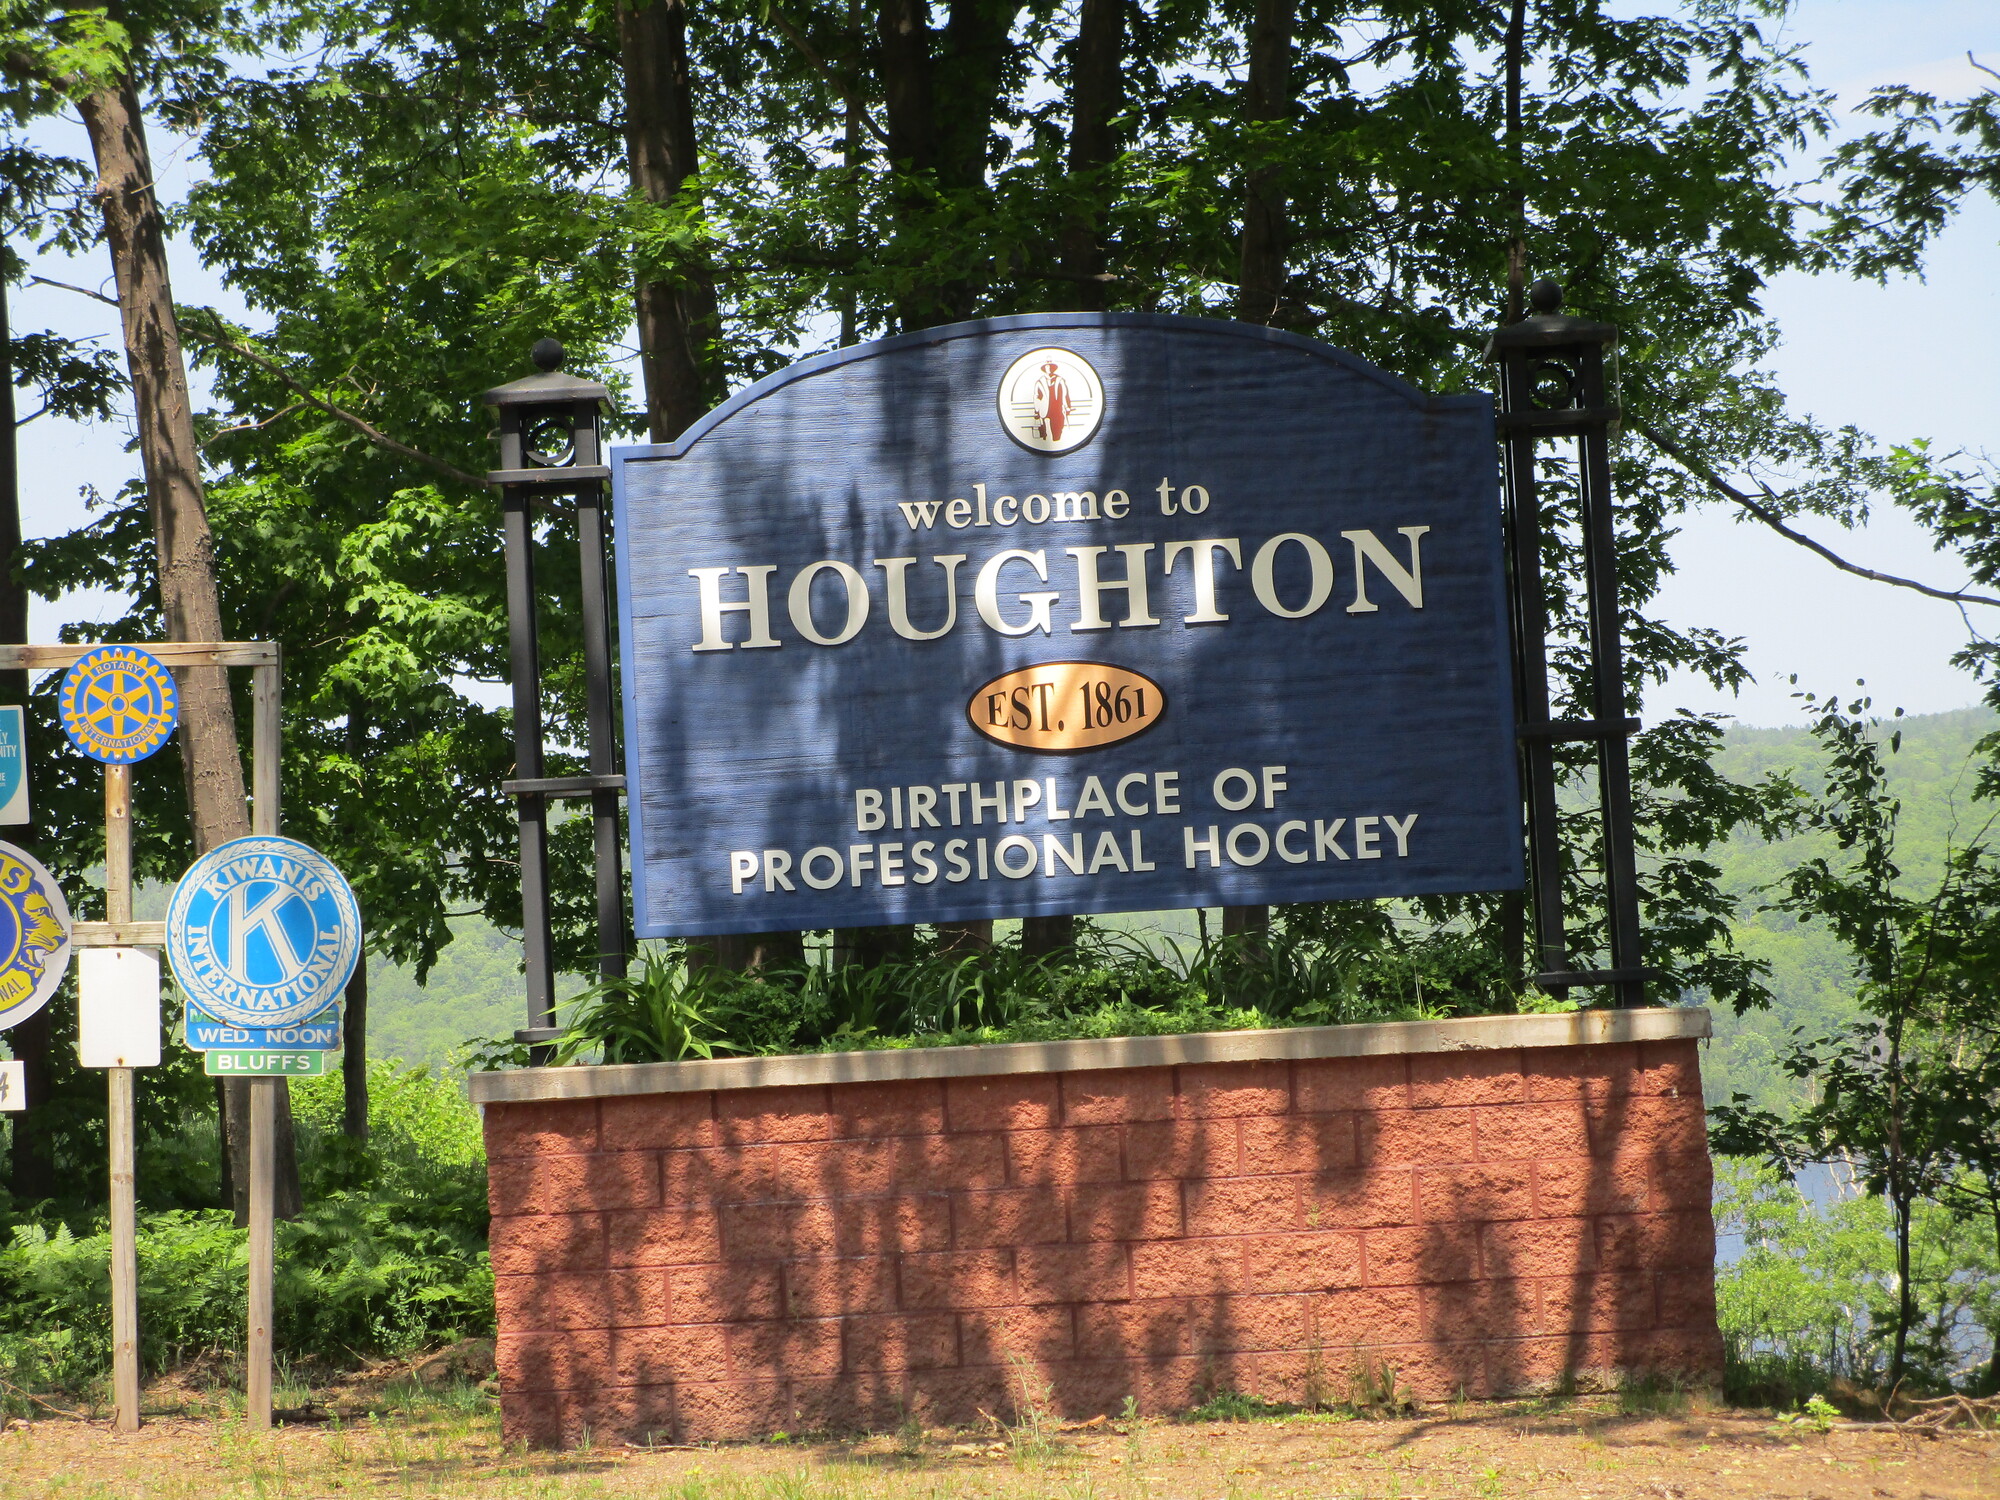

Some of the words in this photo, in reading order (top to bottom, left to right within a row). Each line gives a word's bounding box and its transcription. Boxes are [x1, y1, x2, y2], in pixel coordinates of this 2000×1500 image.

[898, 483, 1131, 530] welcome
[1157, 476, 1210, 515] to
[688, 525, 1431, 653] HOUGHTON
[95, 661, 141, 675] ROTARY
[986, 682, 1065, 732] EST.
[1079, 681, 1148, 730] 1861
[80, 721, 157, 748] INTERNATIONAL
[855, 771, 1181, 832] BIRTHPLACE
[1213, 766, 1287, 812] OF
[202, 856, 326, 901] KIWANIS
[732, 831, 1156, 895] PROFESSIONAL
[1184, 814, 1420, 871] HOCKEY
[226, 880, 306, 984] K
[187, 924, 341, 1011] INTERNATIONAL
[197, 1028, 254, 1043] WED.
[266, 1028, 332, 1044] NOON
[217, 1054, 311, 1070] BLUFFS
